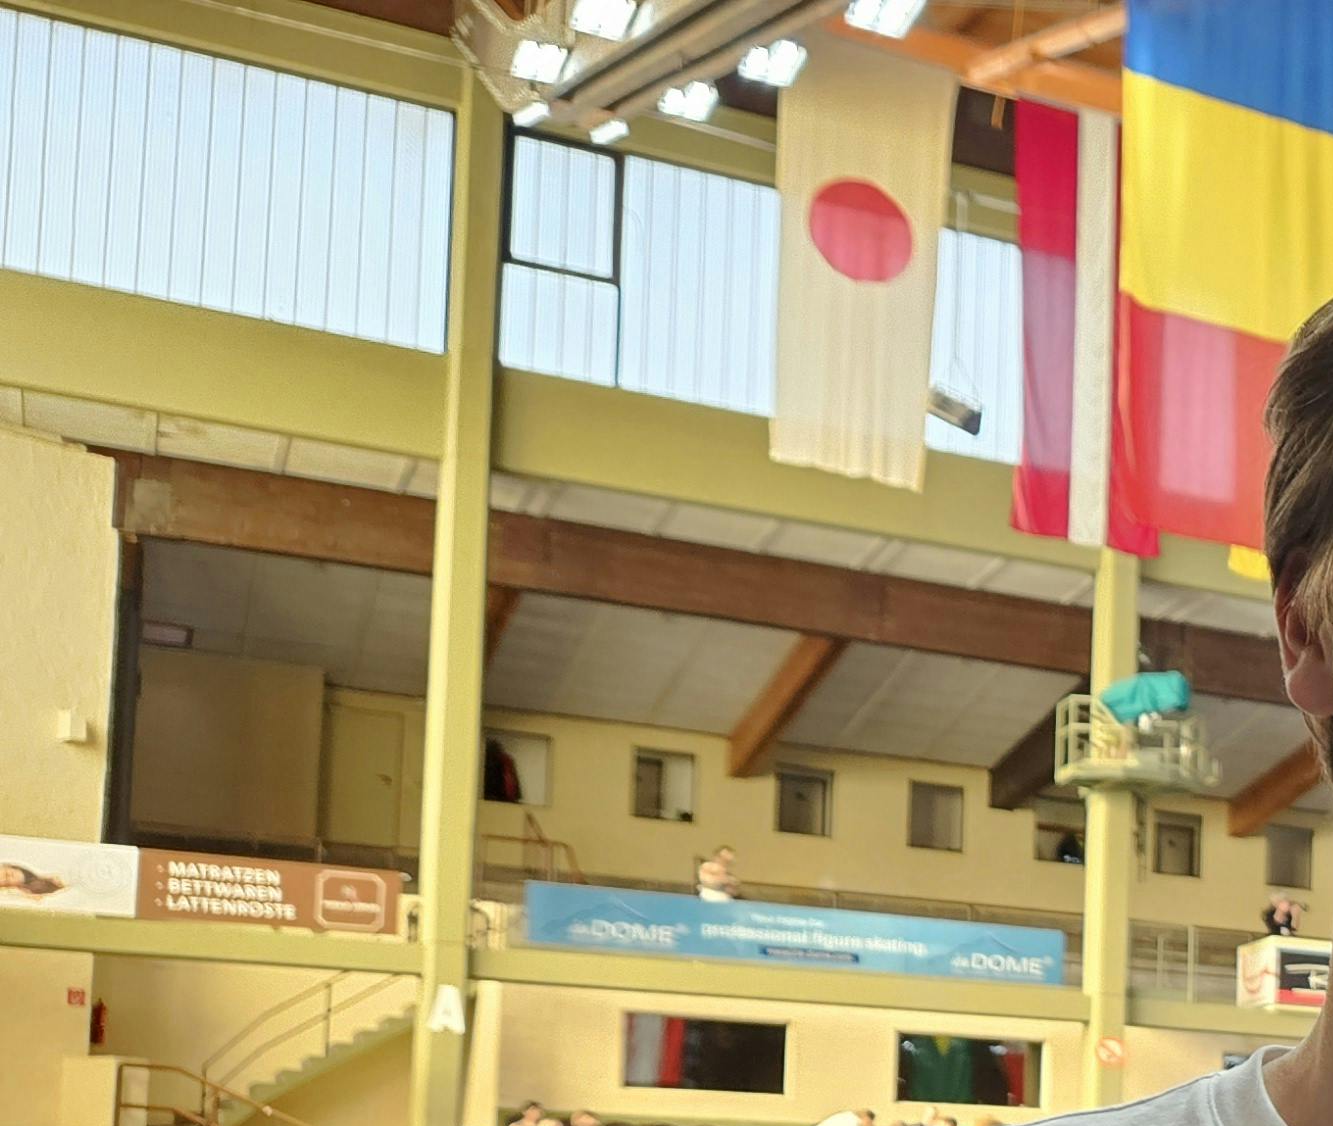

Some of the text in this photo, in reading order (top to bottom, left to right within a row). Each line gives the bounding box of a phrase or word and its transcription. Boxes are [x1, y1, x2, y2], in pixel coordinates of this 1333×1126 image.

[168, 861, 280, 886] MATRATZEN
[167, 878, 283, 902] BETTWAREN
[166, 895, 297, 920] LATTENROSTE
[427, 984, 466, 1034] A
